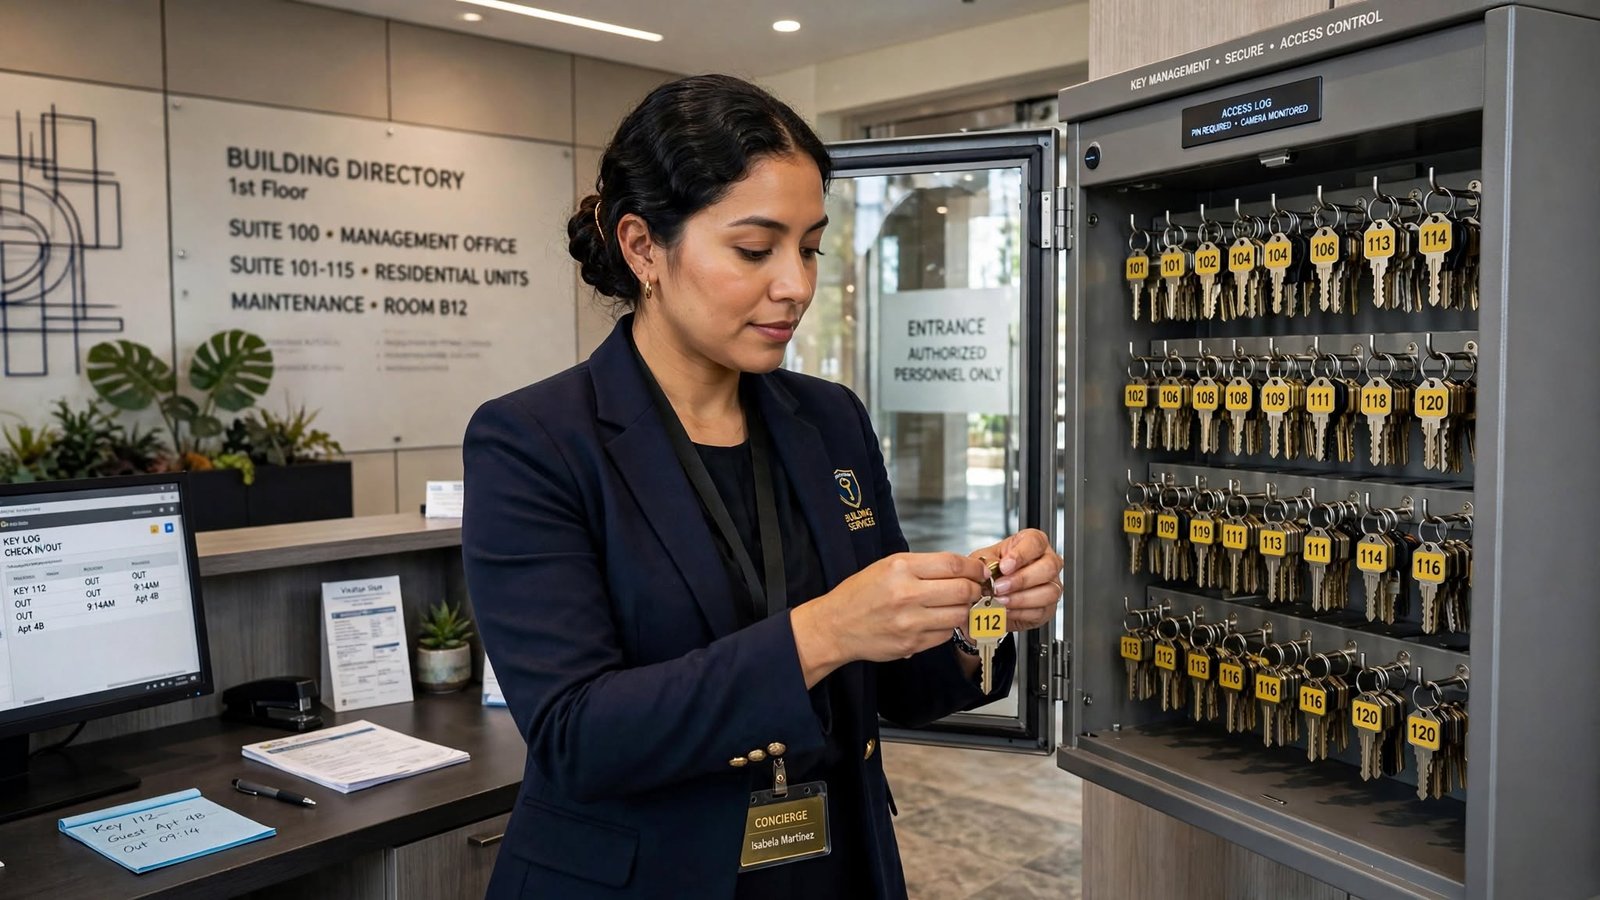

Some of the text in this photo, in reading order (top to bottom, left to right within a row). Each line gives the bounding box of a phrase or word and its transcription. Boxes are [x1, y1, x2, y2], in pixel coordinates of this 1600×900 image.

[1130, 10, 1384, 90] KEY MANAGEMENT SECURE ACCESS CONTROL
[1222, 98, 1272, 118] ACCESS LOG
[1191, 104, 1309, 137] PIN REQUIRED CAMERA MONITORED
[227, 147, 465, 190] BUILDING DIRECTORY
[228, 178, 308, 200] 1st Floor
[229, 219, 518, 254] SUITE 100 MANAGEMENT OFFICE
[1368, 236, 1390, 251] 113
[1424, 230, 1447, 246] 114
[1269, 248, 1287, 262] 104
[1315, 242, 1335, 257] 106
[1199, 256, 1216, 269] 102
[1233, 252, 1250, 265] 104
[230, 256, 529, 286] SUITE 101-115 RESIDENTIAL UNITS
[1130, 262, 1144, 274] 101
[1164, 260, 1179, 272] 101
[232, 292, 468, 316] MAINTENANCE ROOM B12
[908, 318, 986, 337] ENTRANCE
[908, 346, 987, 361] AUTHORIZED
[894, 366, 1002, 382] PERSONNEL ONLY
[1128, 391, 1143, 402] 102
[1163, 391, 1178, 403] 106
[1197, 391, 1214, 404] 108
[1230, 391, 1248, 405] 108
[1266, 392, 1285, 405] 109
[1311, 393, 1329, 406] 111
[1365, 394, 1386, 408] 118
[1420, 396, 1443, 411] 120
[844, 508, 872, 522] BUILDING
[1127, 516, 1141, 528] 109
[848, 517, 876, 531] SERVICES
[1160, 520, 1175, 534] 109
[3, 534, 40, 546] KEY LOG
[1226, 531, 1242, 544] 111
[1263, 536, 1282, 550] 113
[4, 546, 33, 557] CHECK
[1308, 542, 1326, 557] 111
[1361, 549, 1382, 564] 114
[1417, 558, 1440, 575] 116
[85, 577, 100, 586] OUT
[132, 571, 146, 580] OUT
[14, 584, 46, 595] KEY 112
[86, 588, 101, 598] OUT
[15, 598, 32, 608] OUT
[136, 592, 159, 604] Apt 4B
[16, 611, 32, 621] OUT
[975, 615, 1000, 630] 112
[18, 622, 45, 634] Apt 4B
[1123, 640, 1138, 655] 113
[1157, 650, 1172, 664] 112
[1190, 659, 1206, 674] 113
[1223, 669, 1239, 683] 116
[1259, 681, 1276, 696] 116
[1303, 692, 1322, 708] 116
[1356, 707, 1377, 724] 120
[1411, 724, 1435, 742] 120
[92, 814, 158, 833] Key 112
[755, 810, 808, 828] CONCIERGE
[108, 812, 206, 843] Guest Apt 4B
[124, 827, 200, 853] Out 09:14
[751, 836, 779, 850] Isabela
